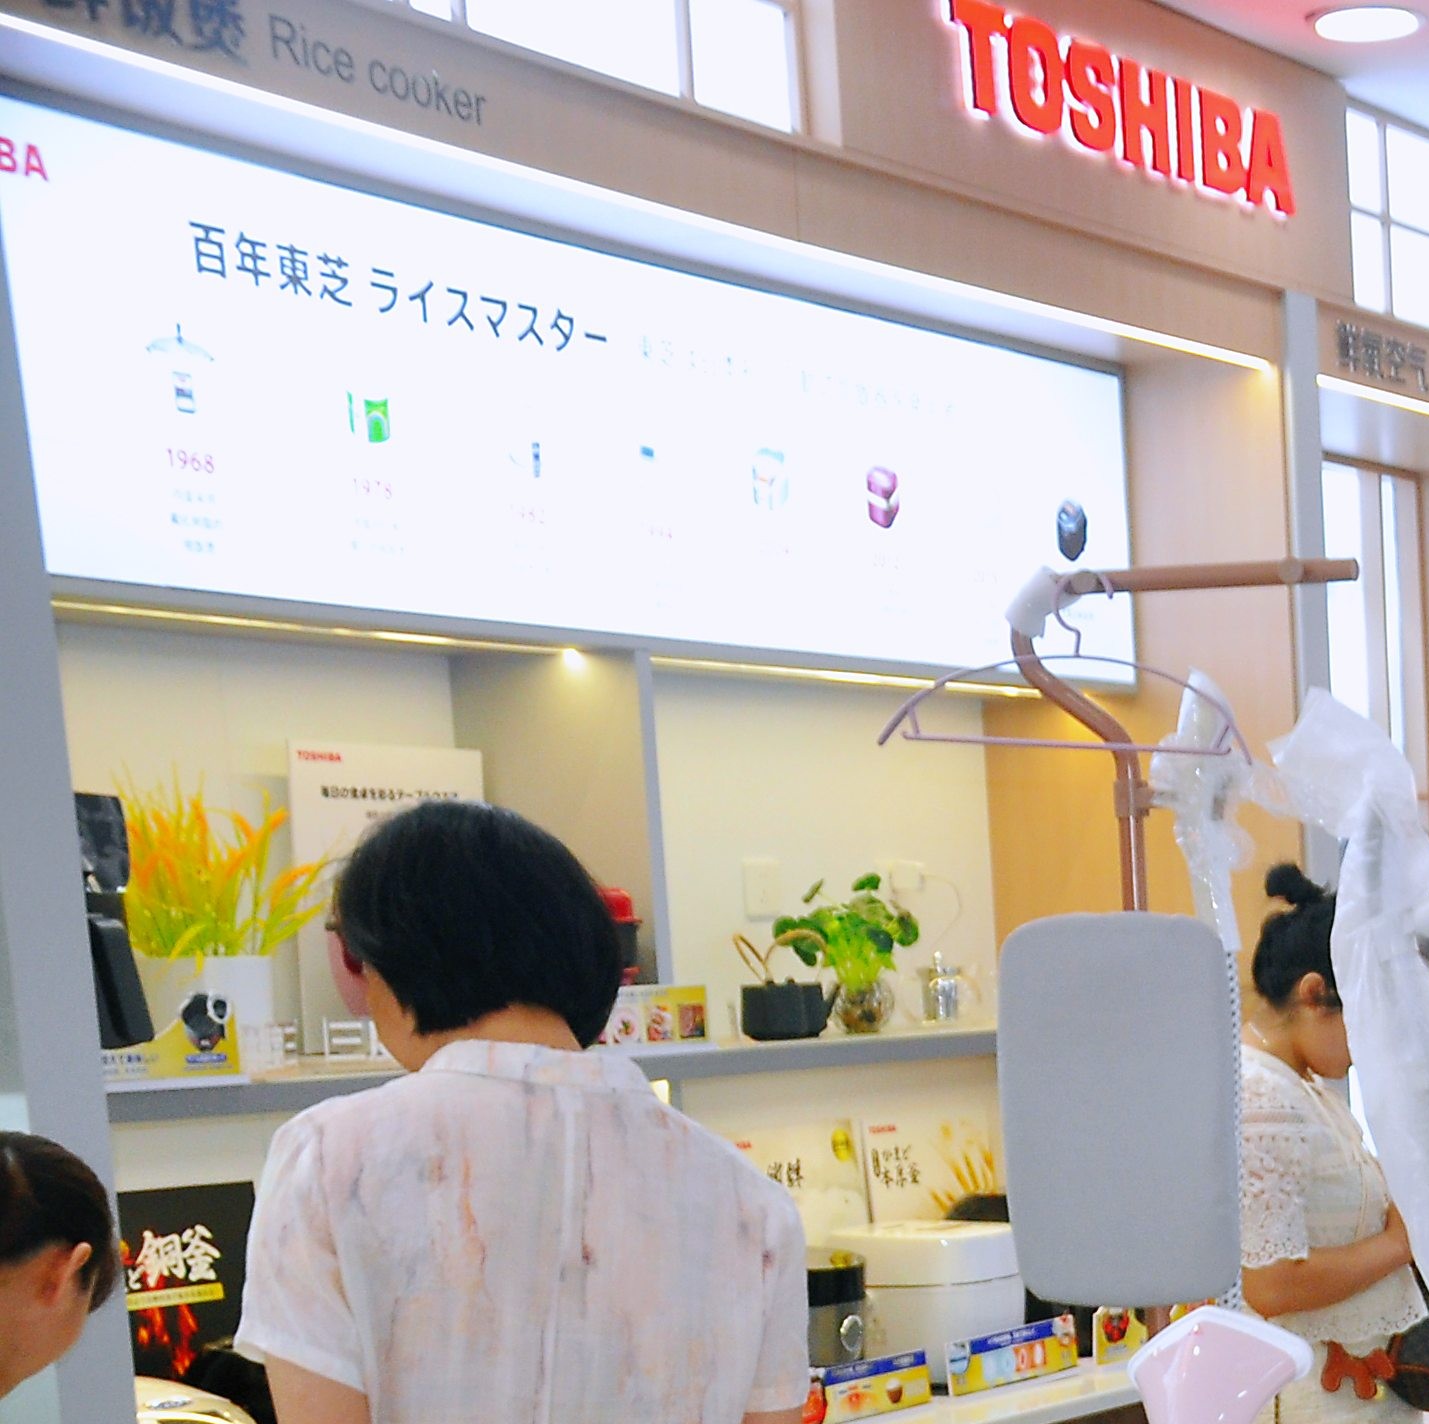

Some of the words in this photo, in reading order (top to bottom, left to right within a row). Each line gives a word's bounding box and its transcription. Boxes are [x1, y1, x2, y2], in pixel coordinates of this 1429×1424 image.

[268, 14, 356, 84] Rice
[368, 58, 487, 127] cooker
[947, 0, 1297, 216] TOSHIBA
[189, 221, 353, 308] 百年東芝
[370, 267, 608, 352] ライスマスター
[167, 448, 216, 475] 1968
[297, 751, 342, 763] TOSHIBA
